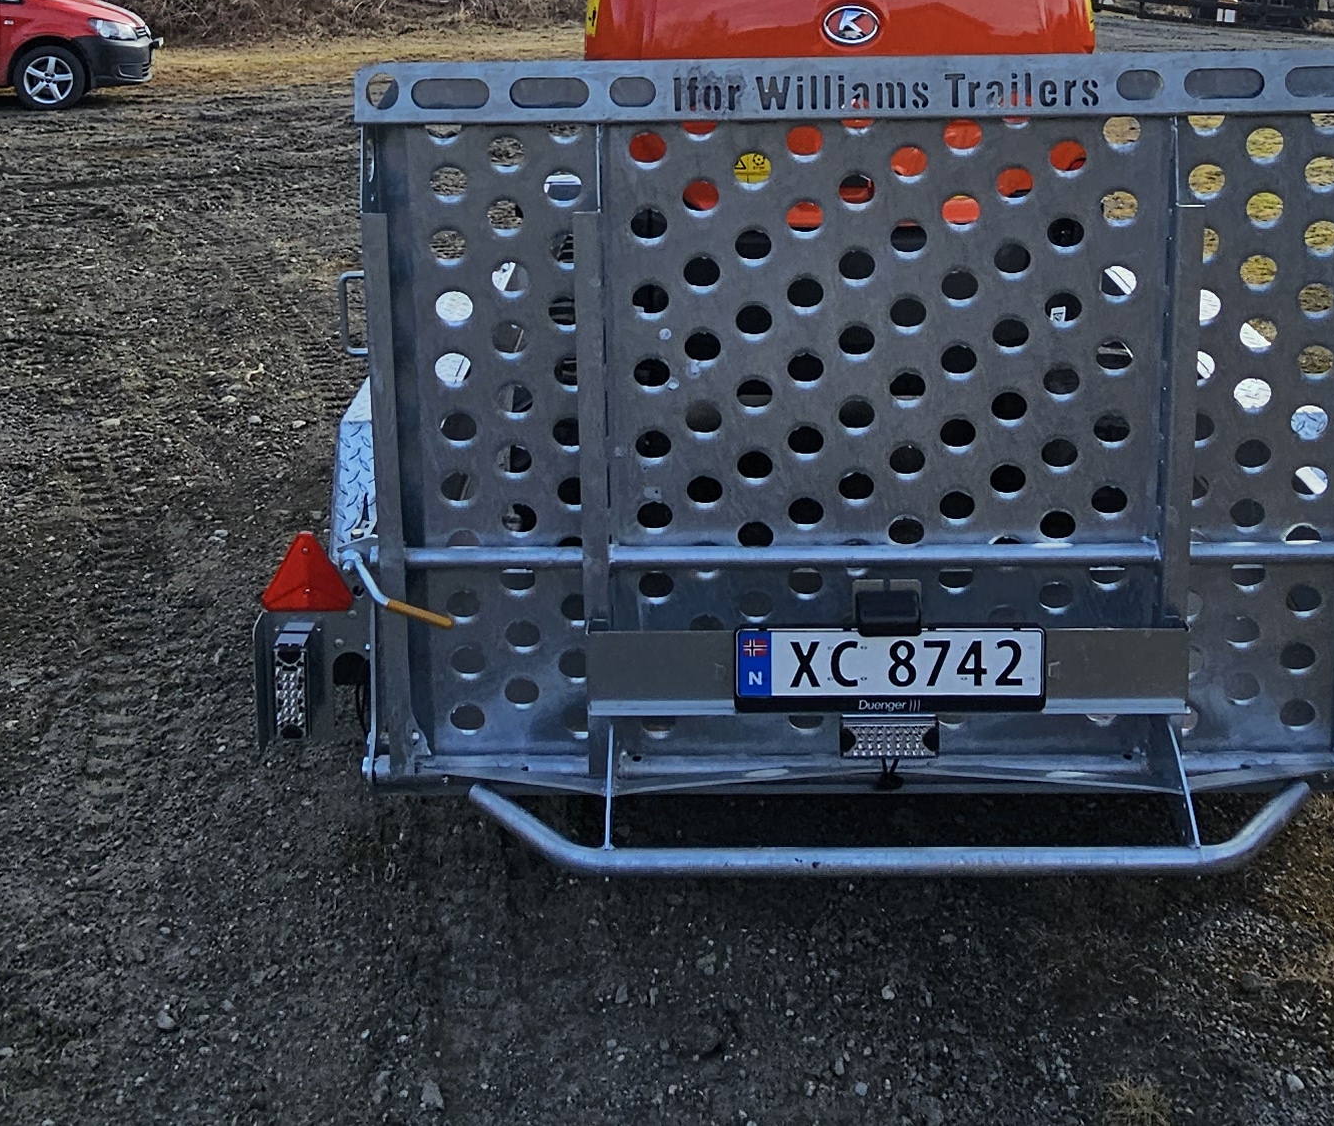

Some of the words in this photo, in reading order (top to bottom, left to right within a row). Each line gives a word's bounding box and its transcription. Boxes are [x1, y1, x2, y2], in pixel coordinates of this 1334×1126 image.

[673, 76, 741, 112] Ifor
[756, 74, 930, 111] Williams
[944, 72, 1099, 109] Trailers
[789, 640, 859, 688] XC
[887, 639, 1023, 687] 8742
[748, 671, 762, 686] N
[857, 699, 907, 711] Duenger
